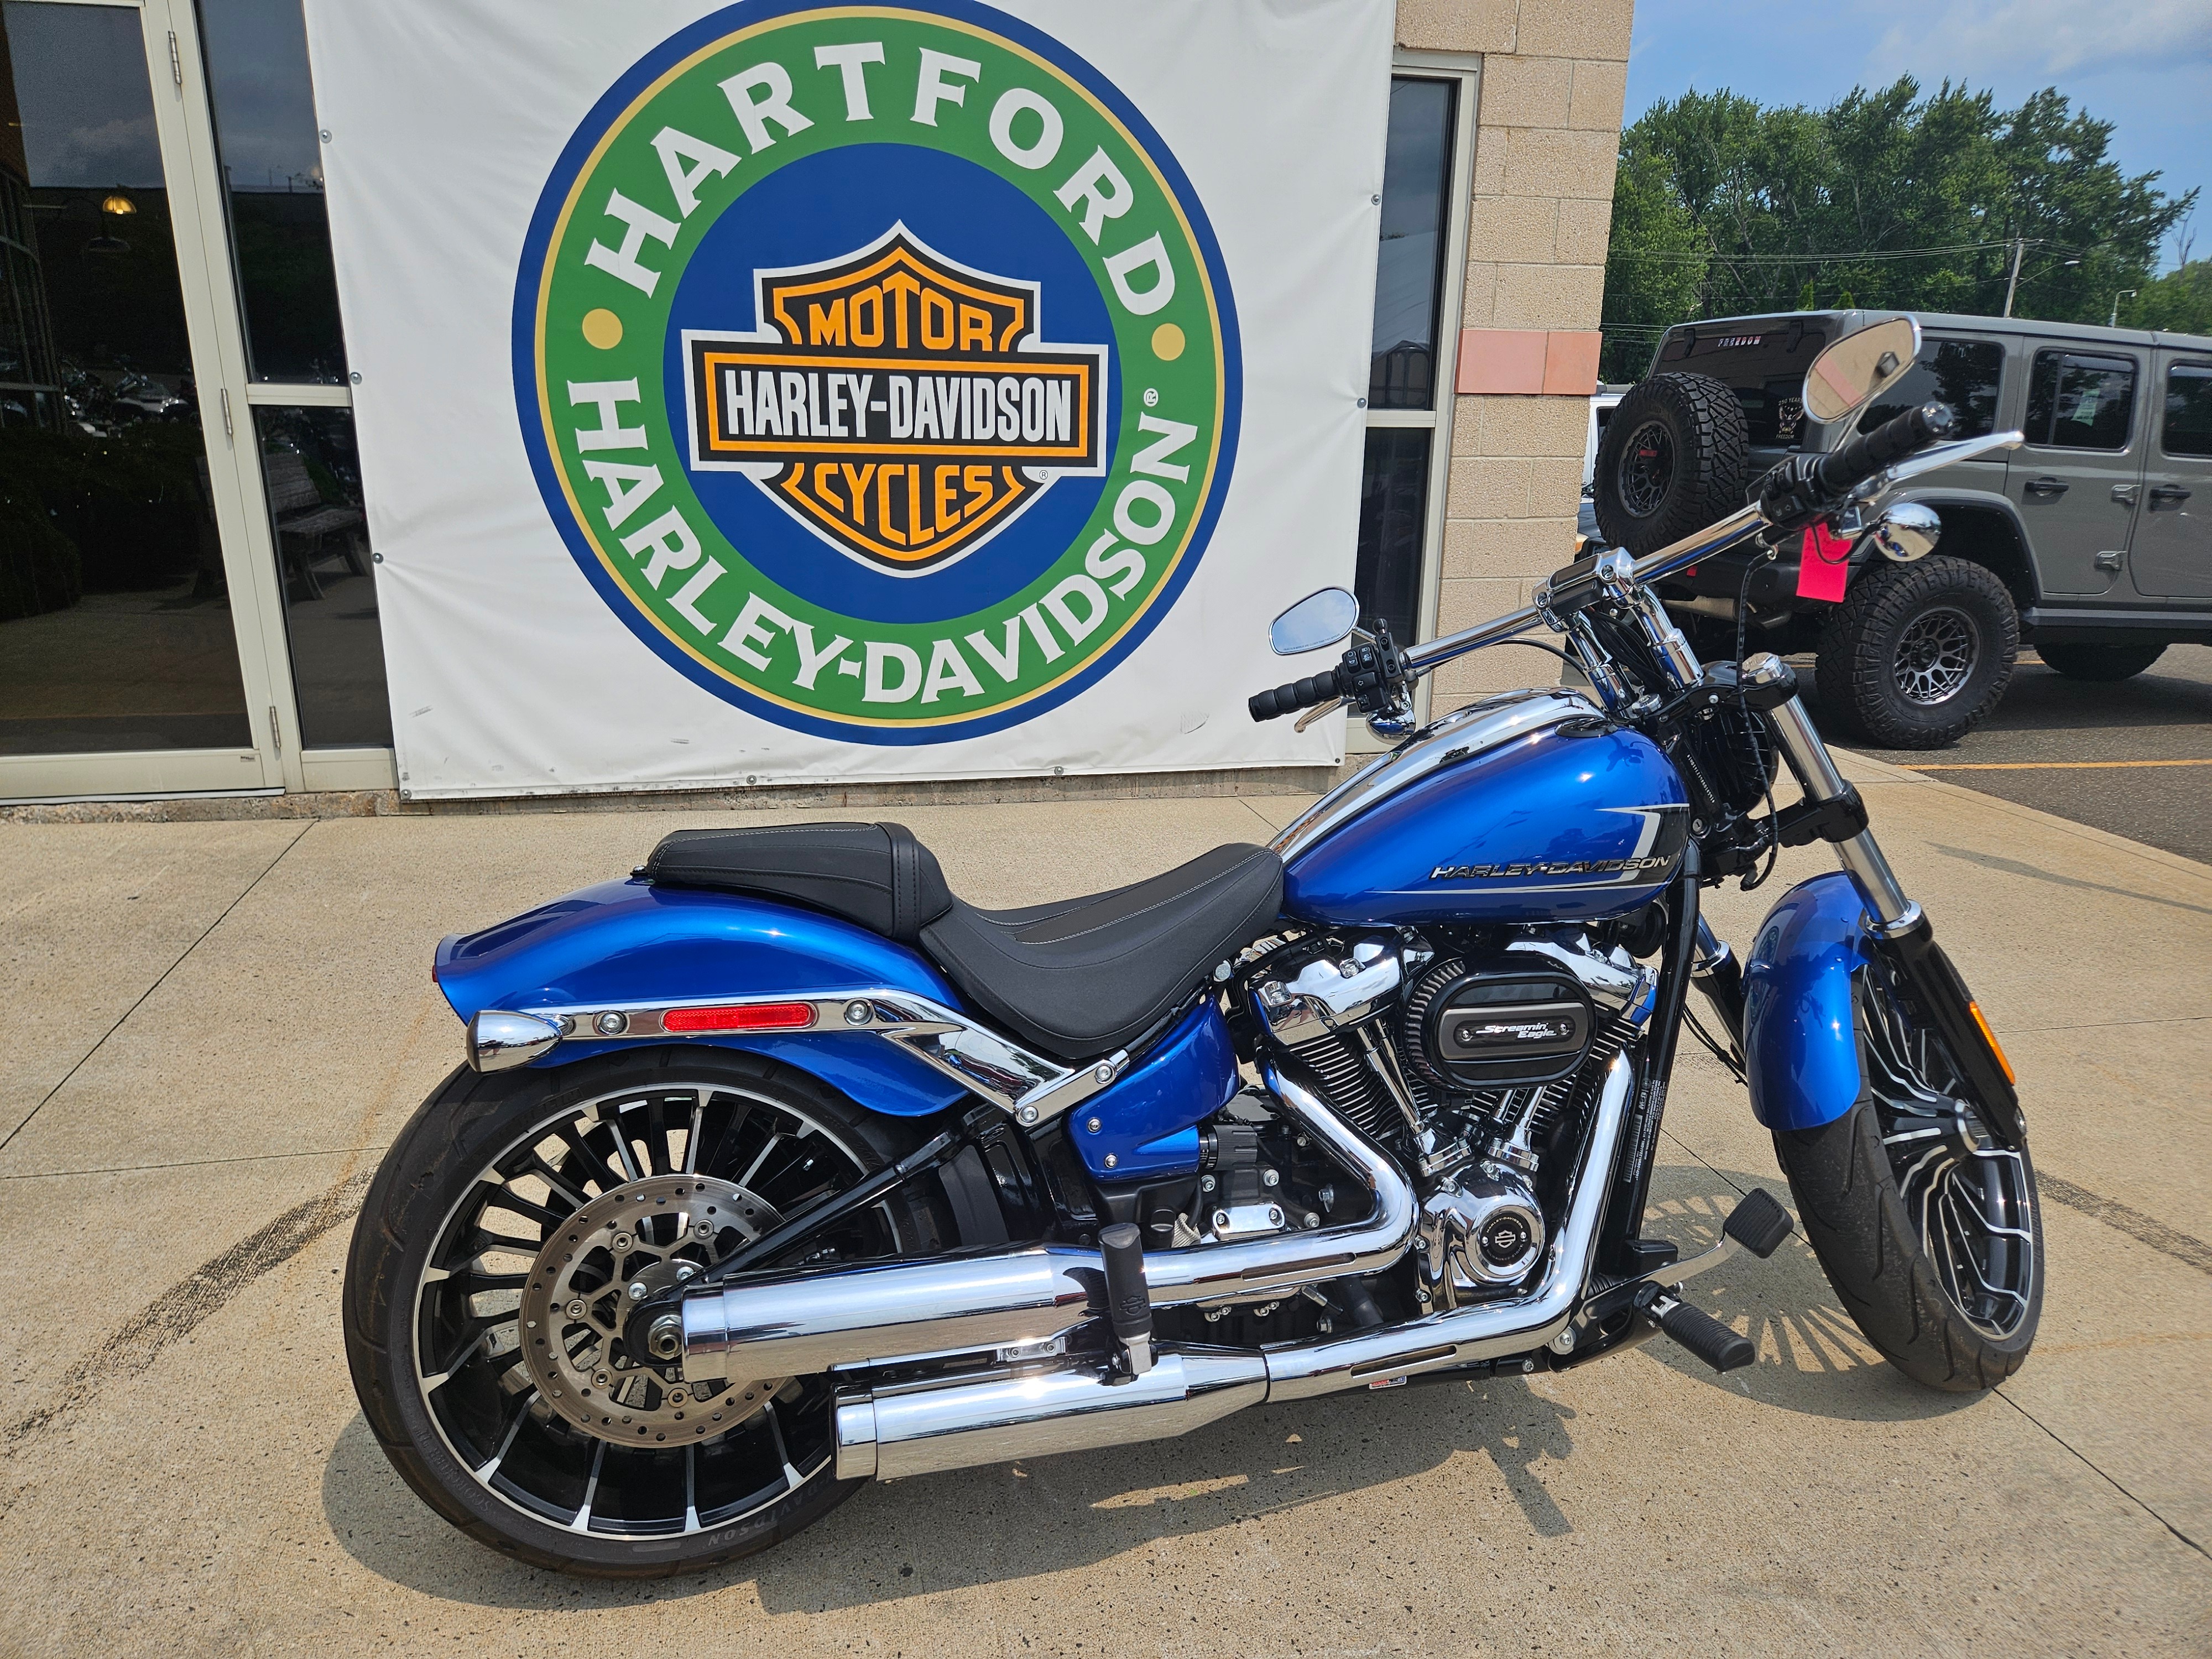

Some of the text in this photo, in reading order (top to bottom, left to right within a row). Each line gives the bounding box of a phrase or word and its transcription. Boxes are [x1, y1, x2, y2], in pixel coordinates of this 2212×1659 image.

[584, 41, 1175, 316] HARTFORD
[808, 270, 995, 352] MOTOR
[1718, 336, 1761, 347] FREEDOM
[725, 369, 1071, 441] HARLEY-DAVIDSON
[815, 463, 994, 546] CYCLES
[567, 378, 1198, 704] HARLEY-DAVIDSON
[1430, 854, 1671, 879] HARLEY-DAVIDSON
[1475, 1022, 1549, 1034] Screamin'
[1517, 1029, 1557, 1039] Eagle
[1486, 1217, 1524, 1233] HARLEY-DAVIDSON
